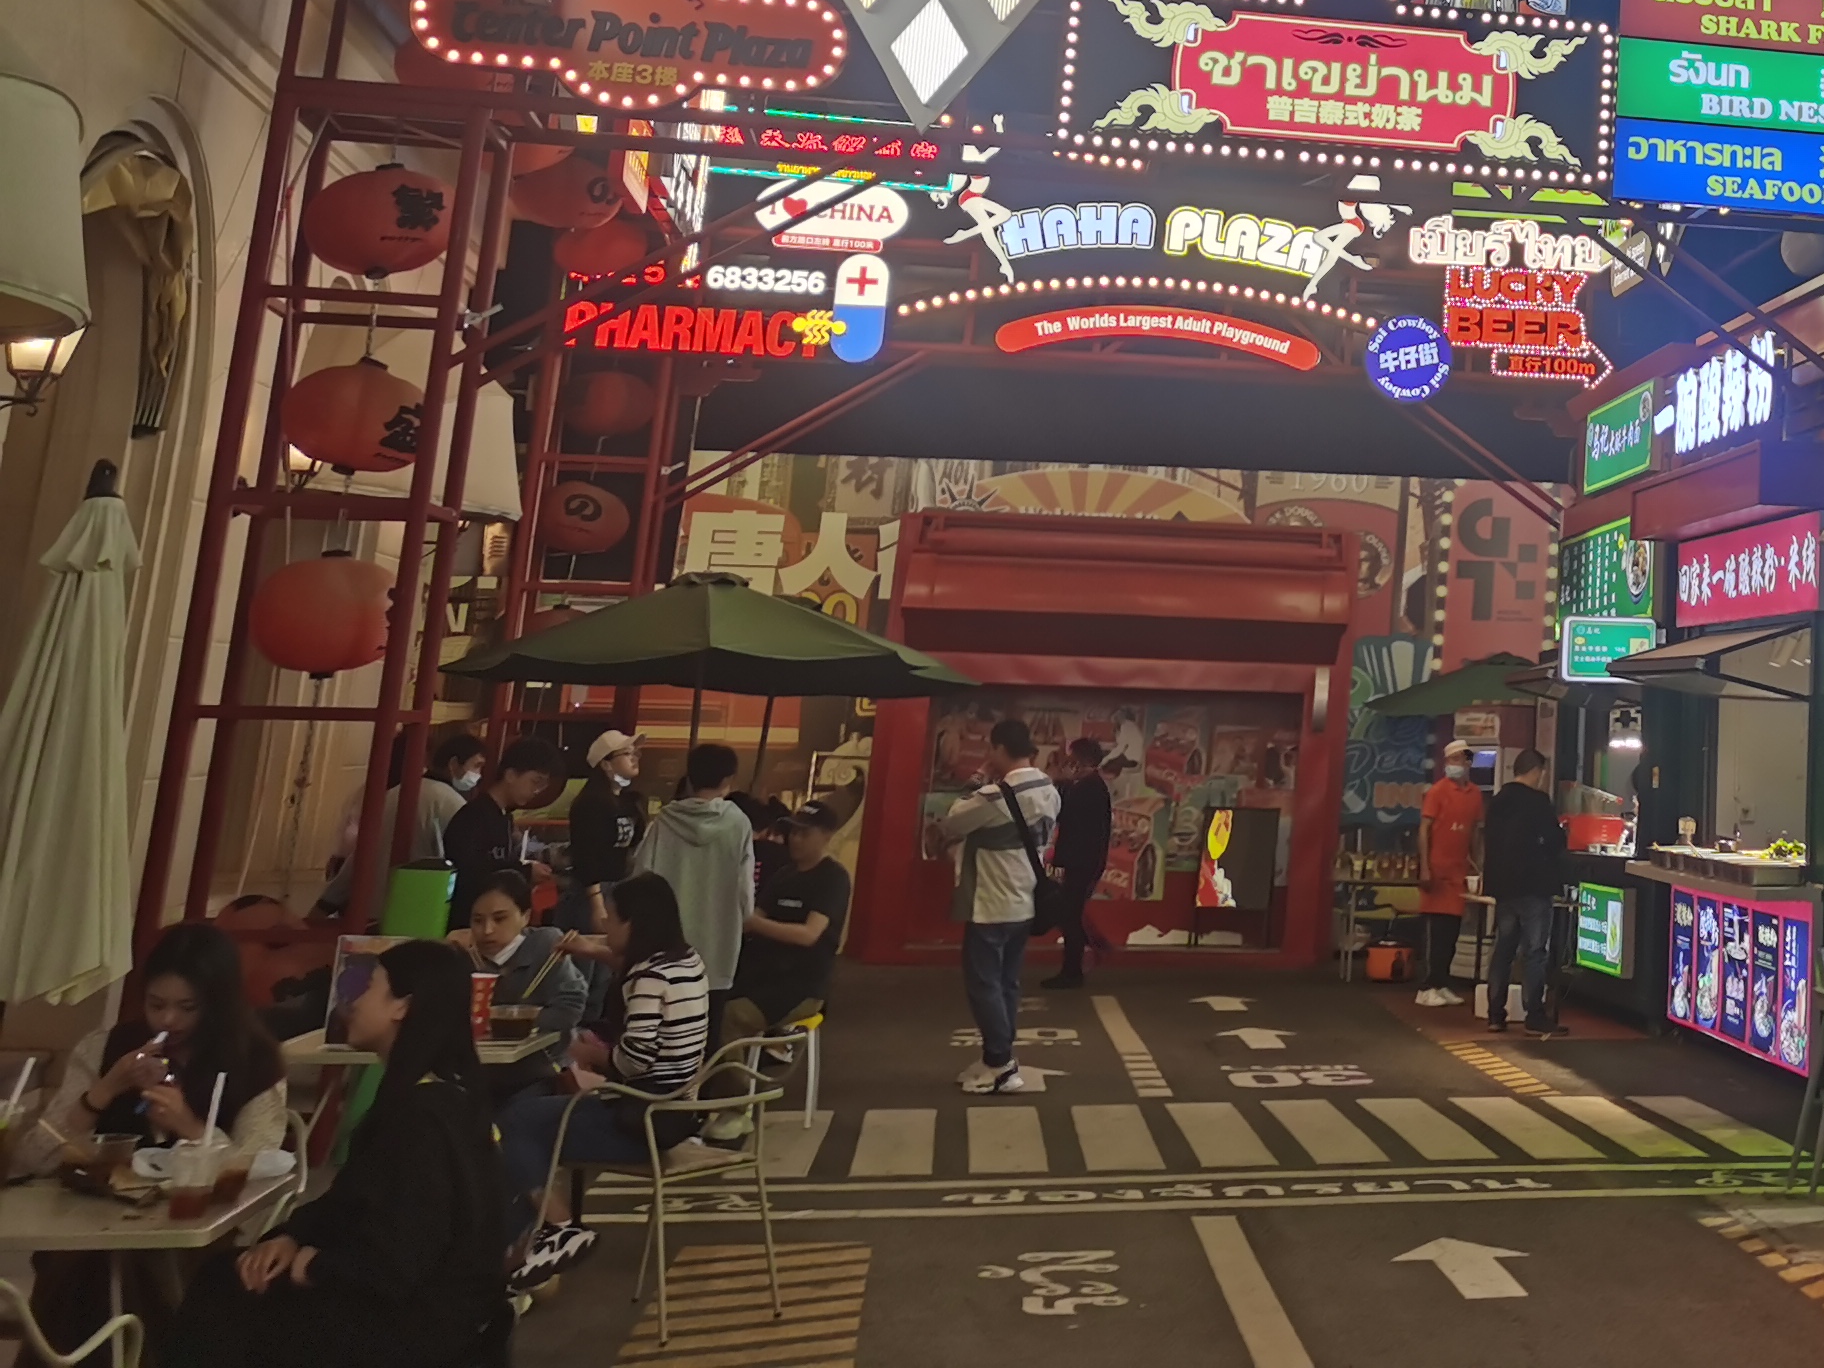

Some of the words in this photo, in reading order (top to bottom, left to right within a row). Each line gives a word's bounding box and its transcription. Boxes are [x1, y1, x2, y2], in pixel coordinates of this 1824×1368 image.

[586, 11, 699, 60] Point
[702, 21, 814, 69] Plaza
[1700, 13, 1802, 44] SHARK
[1198, 46, 1495, 110] ชาเขย่านม
[1266, 94, 1424, 133] 普吉泰式奶茶
[1701, 94, 1774, 121] BIRD
[1000, 203, 1155, 259] HAHA
[1166, 206, 1320, 276] PLAZA
[706, 264, 826, 295] 6833256
[1450, 267, 1587, 304] LUCKY
[1034, 319, 1063, 337] The
[1067, 313, 1117, 332] Worlds
[1119, 312, 1173, 332] Largest
[1174, 315, 1212, 335] Adult
[1212, 319, 1292, 355] Playground
[1367, 327, 1388, 354] Soi
[1387, 317, 1442, 342] Cowboy
[1448, 307, 1585, 349] BEER
[1379, 342, 1440, 374] 牛仔街
[1507, 354, 1596, 376] 直行100m
[1377, 375, 1431, 400] Cowboy
